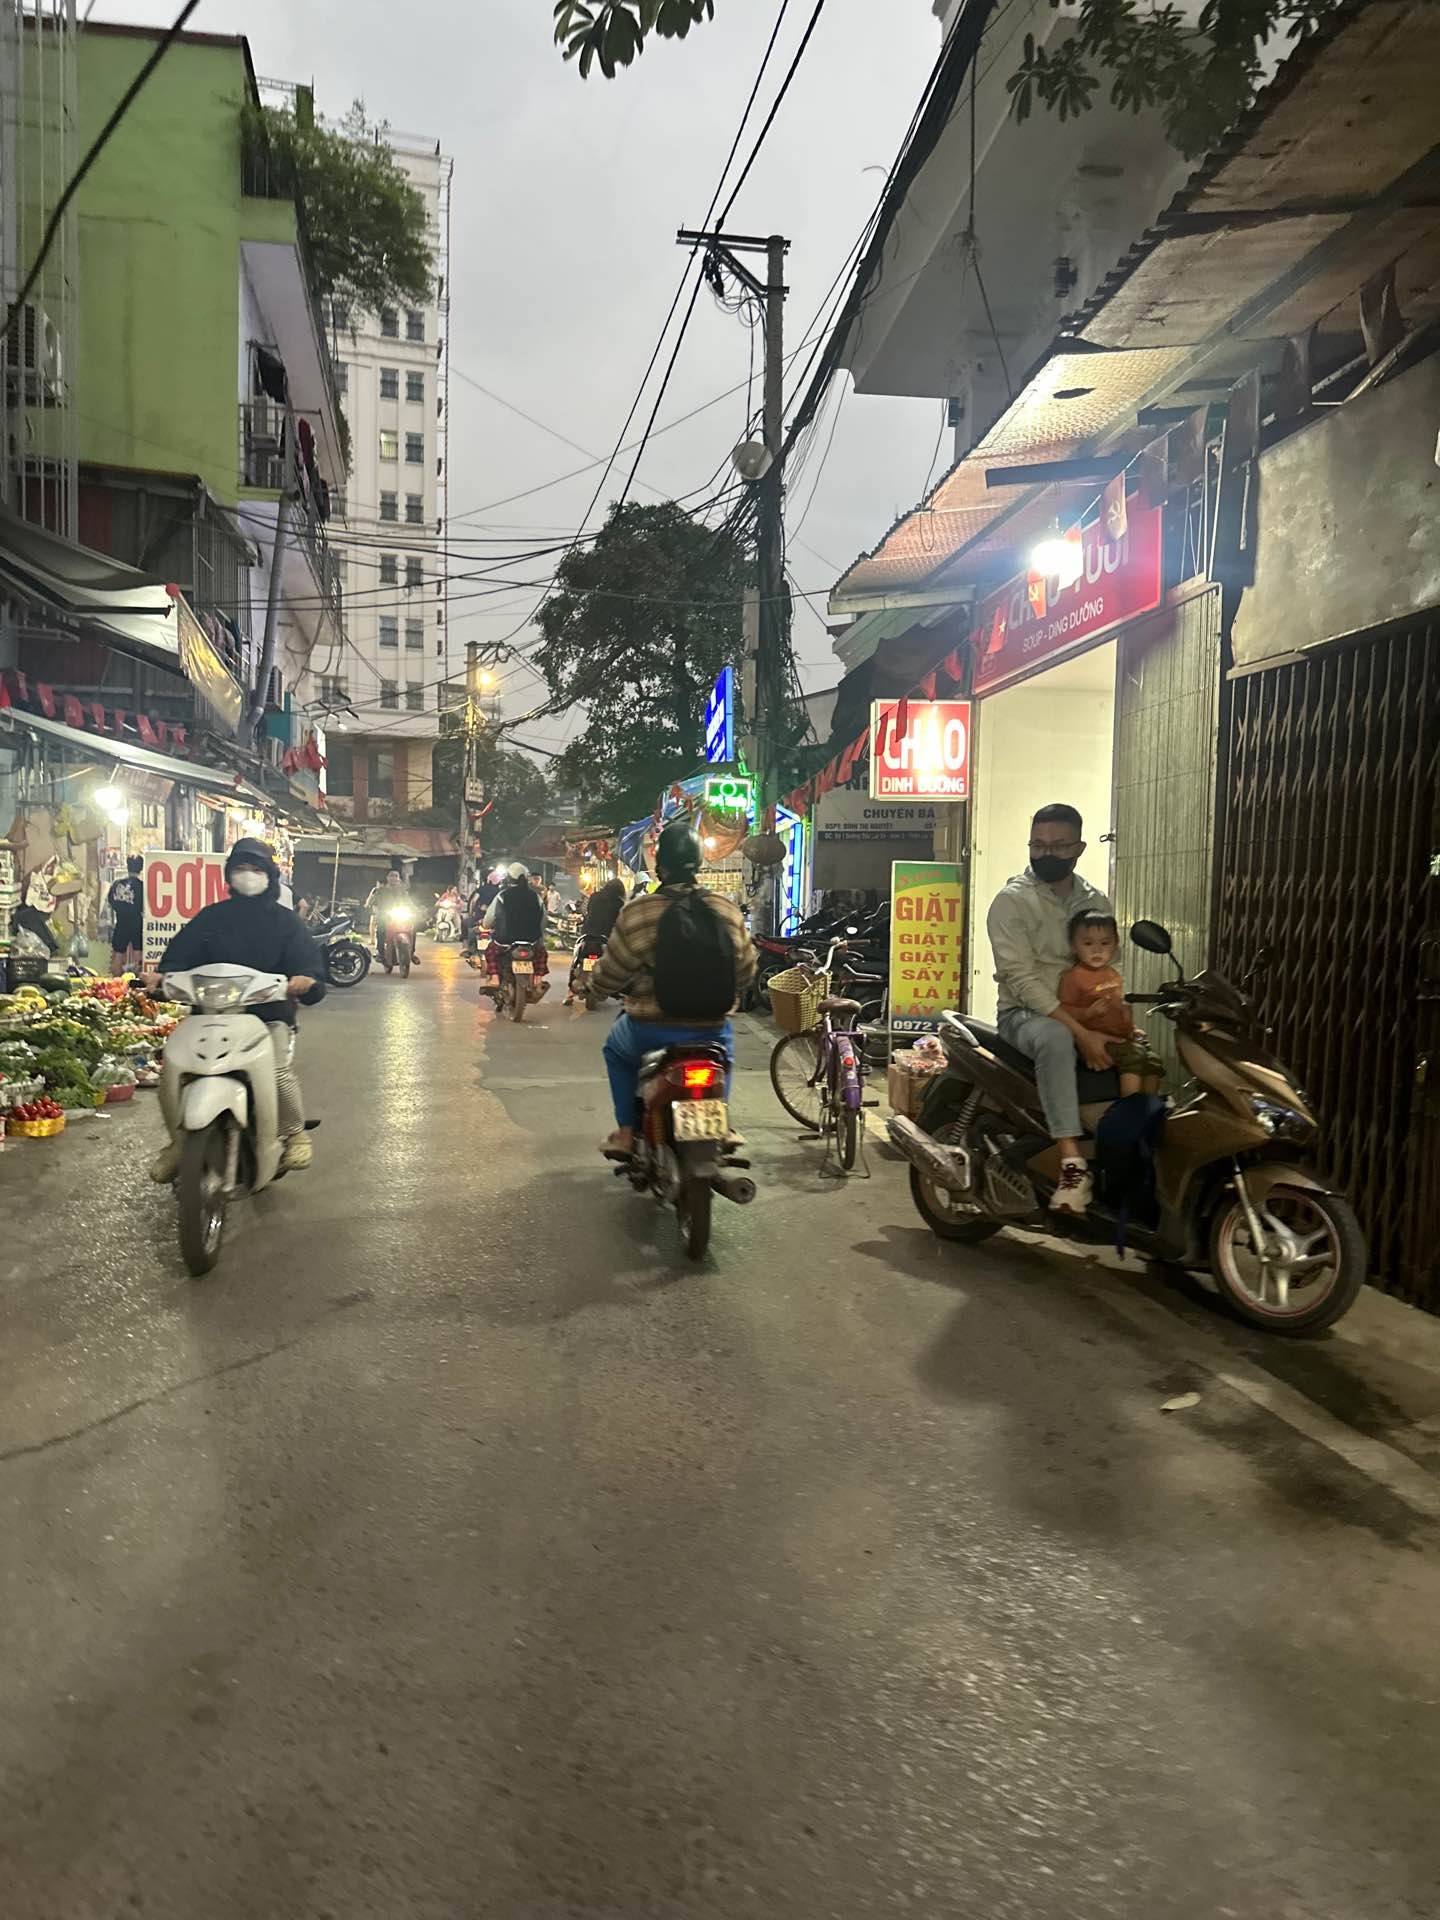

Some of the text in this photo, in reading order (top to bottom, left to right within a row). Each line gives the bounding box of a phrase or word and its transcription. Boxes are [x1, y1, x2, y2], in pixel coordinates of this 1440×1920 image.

[863, 806, 914, 819] CHUYÊN
[896, 892, 960, 927] GIẶT
[147, 920, 177, 932] BÌNH
[899, 931, 948, 948] GIẶT
[900, 950, 949, 966] GIẶT
[901, 966, 944, 982] SẤY
[893, 1020, 933, 1031] 0972
